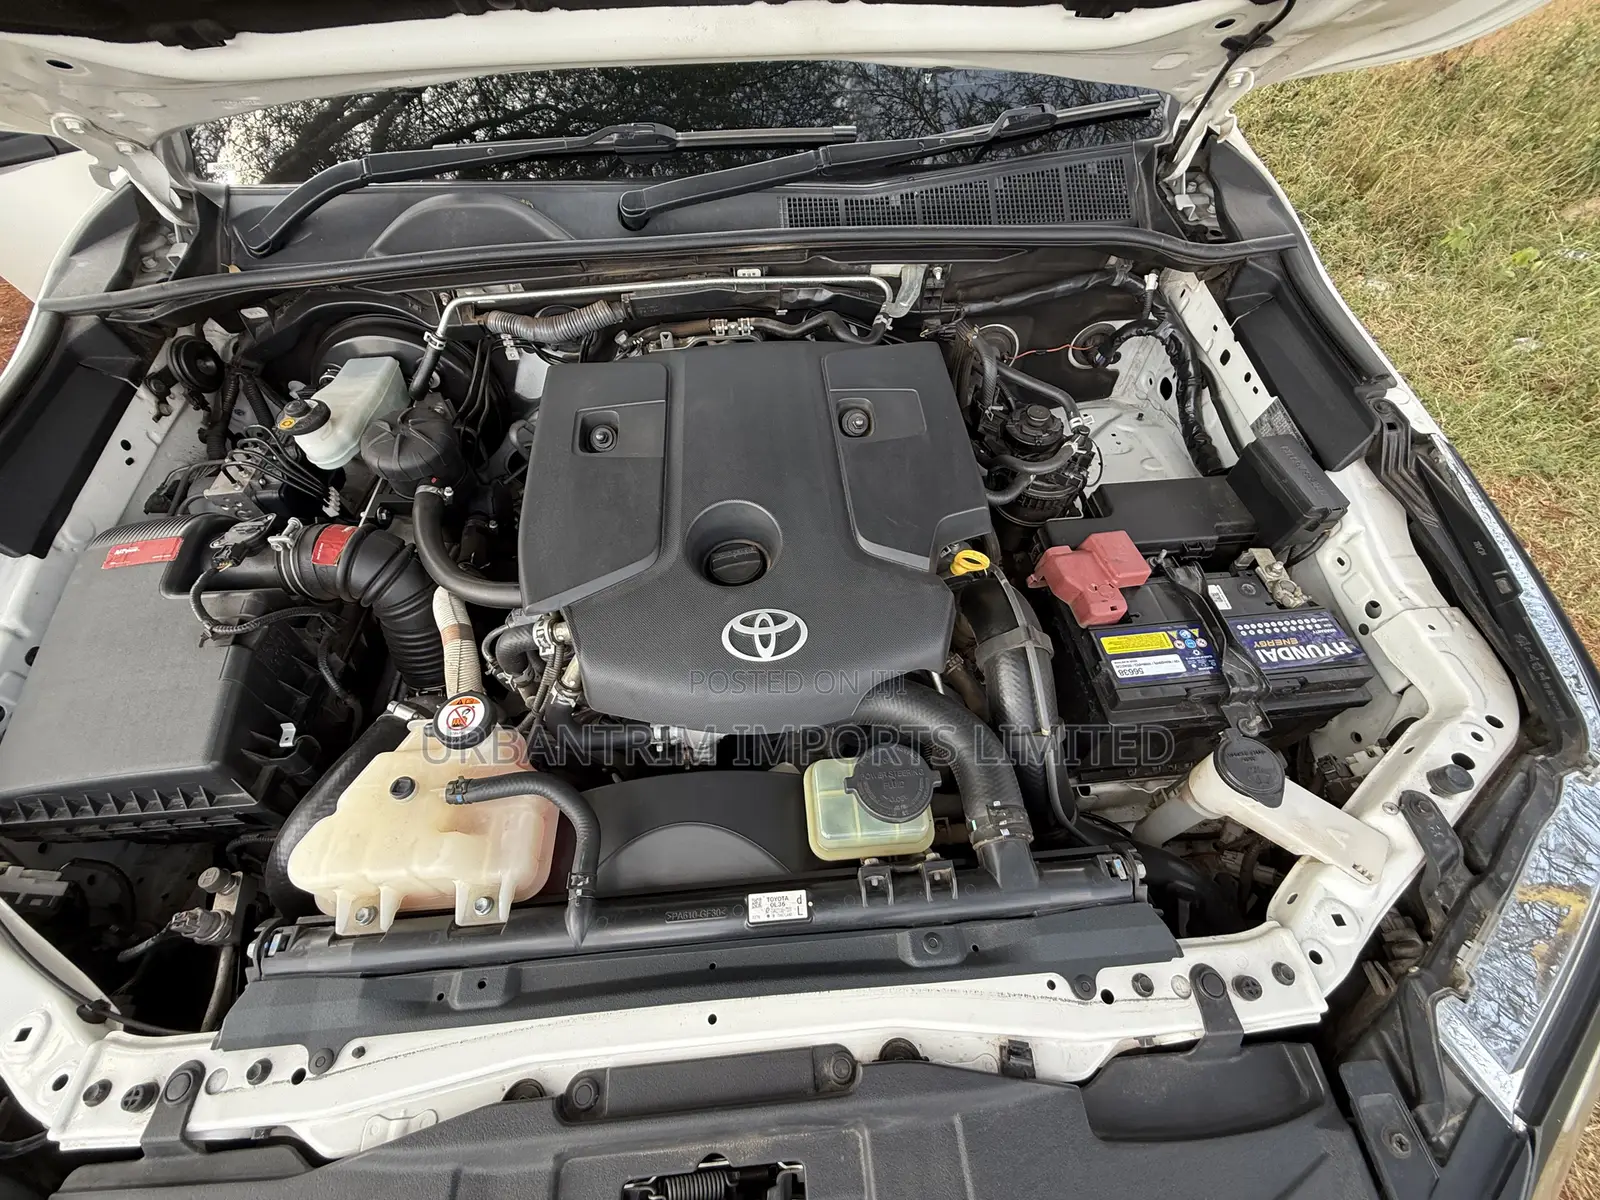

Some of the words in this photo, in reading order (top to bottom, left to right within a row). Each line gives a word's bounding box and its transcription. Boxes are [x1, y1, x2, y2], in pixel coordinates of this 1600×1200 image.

[1254, 637, 1299, 648] ENERGY
[1255, 641, 1353, 664] HYUNDAI
[1118, 667, 1144, 677] 56638
[860, 771, 887, 780] POWER
[888, 768, 925, 778] STEERING
[883, 780, 905, 790] FLUID
